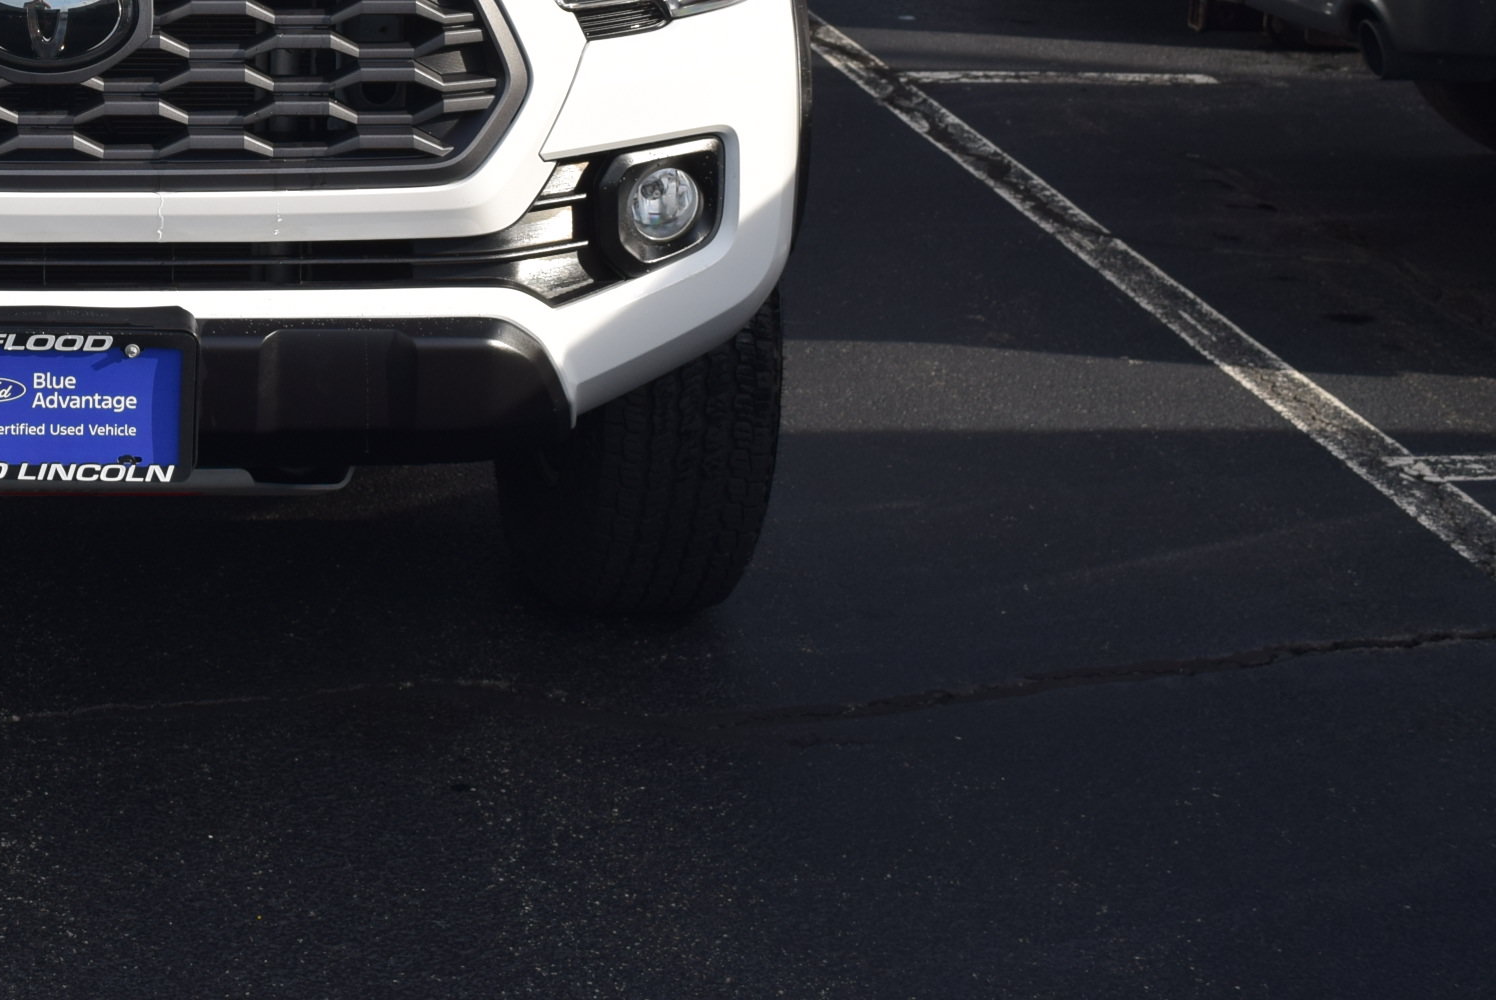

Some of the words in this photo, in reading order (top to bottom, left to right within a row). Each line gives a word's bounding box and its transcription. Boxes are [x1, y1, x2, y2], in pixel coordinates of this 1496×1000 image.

[33, 372, 76, 389] Blue
[32, 392, 137, 412] Advantage
[50, 424, 84, 436] Used
[88, 424, 137, 437] Vehicle
[17, 462, 175, 482] LINCOLN
